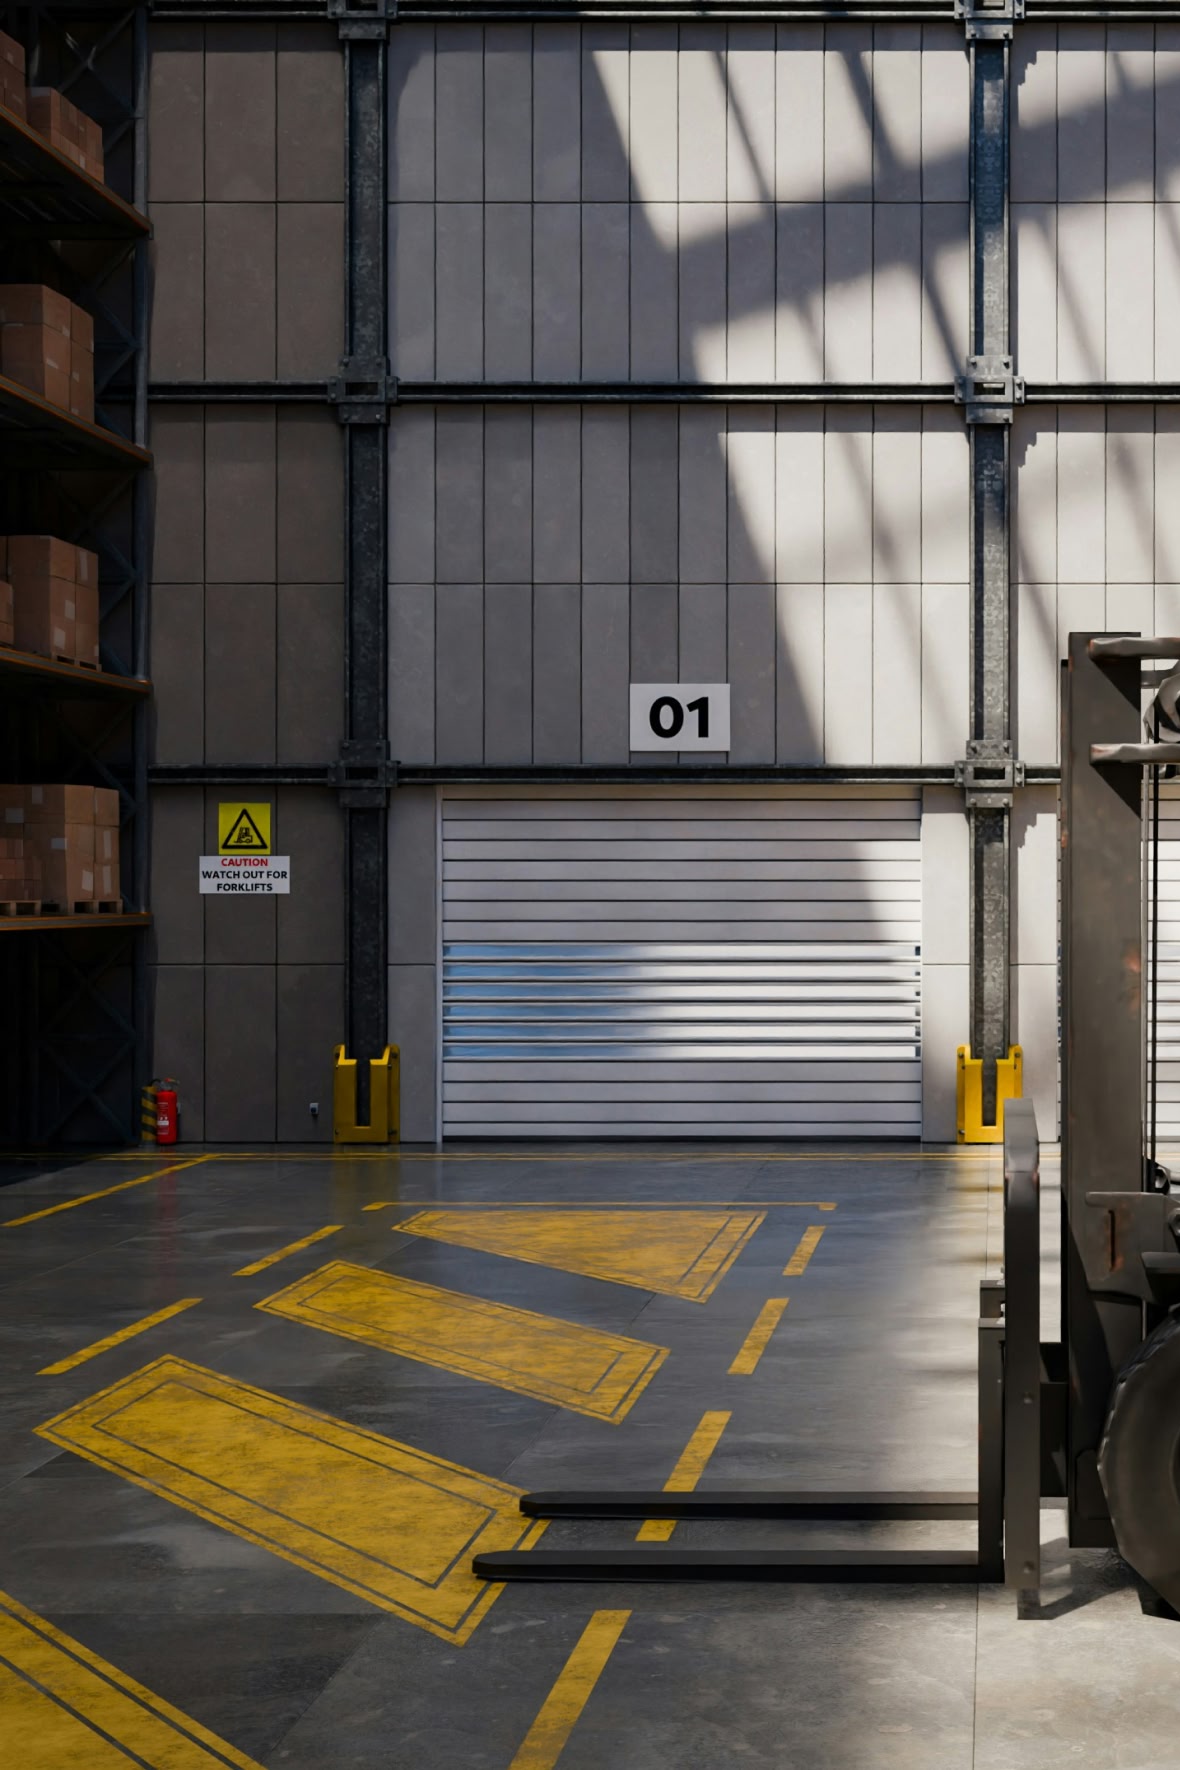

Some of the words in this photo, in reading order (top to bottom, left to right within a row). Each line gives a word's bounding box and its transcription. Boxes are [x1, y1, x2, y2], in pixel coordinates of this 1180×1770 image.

[649, 695, 709, 739] 01
[220, 858, 269, 867] CAUTION
[202, 870, 240, 879] WATCH
[242, 870, 265, 879] OUT
[266, 870, 288, 879] FOR
[216, 883, 273, 891] FORKLIFTS
